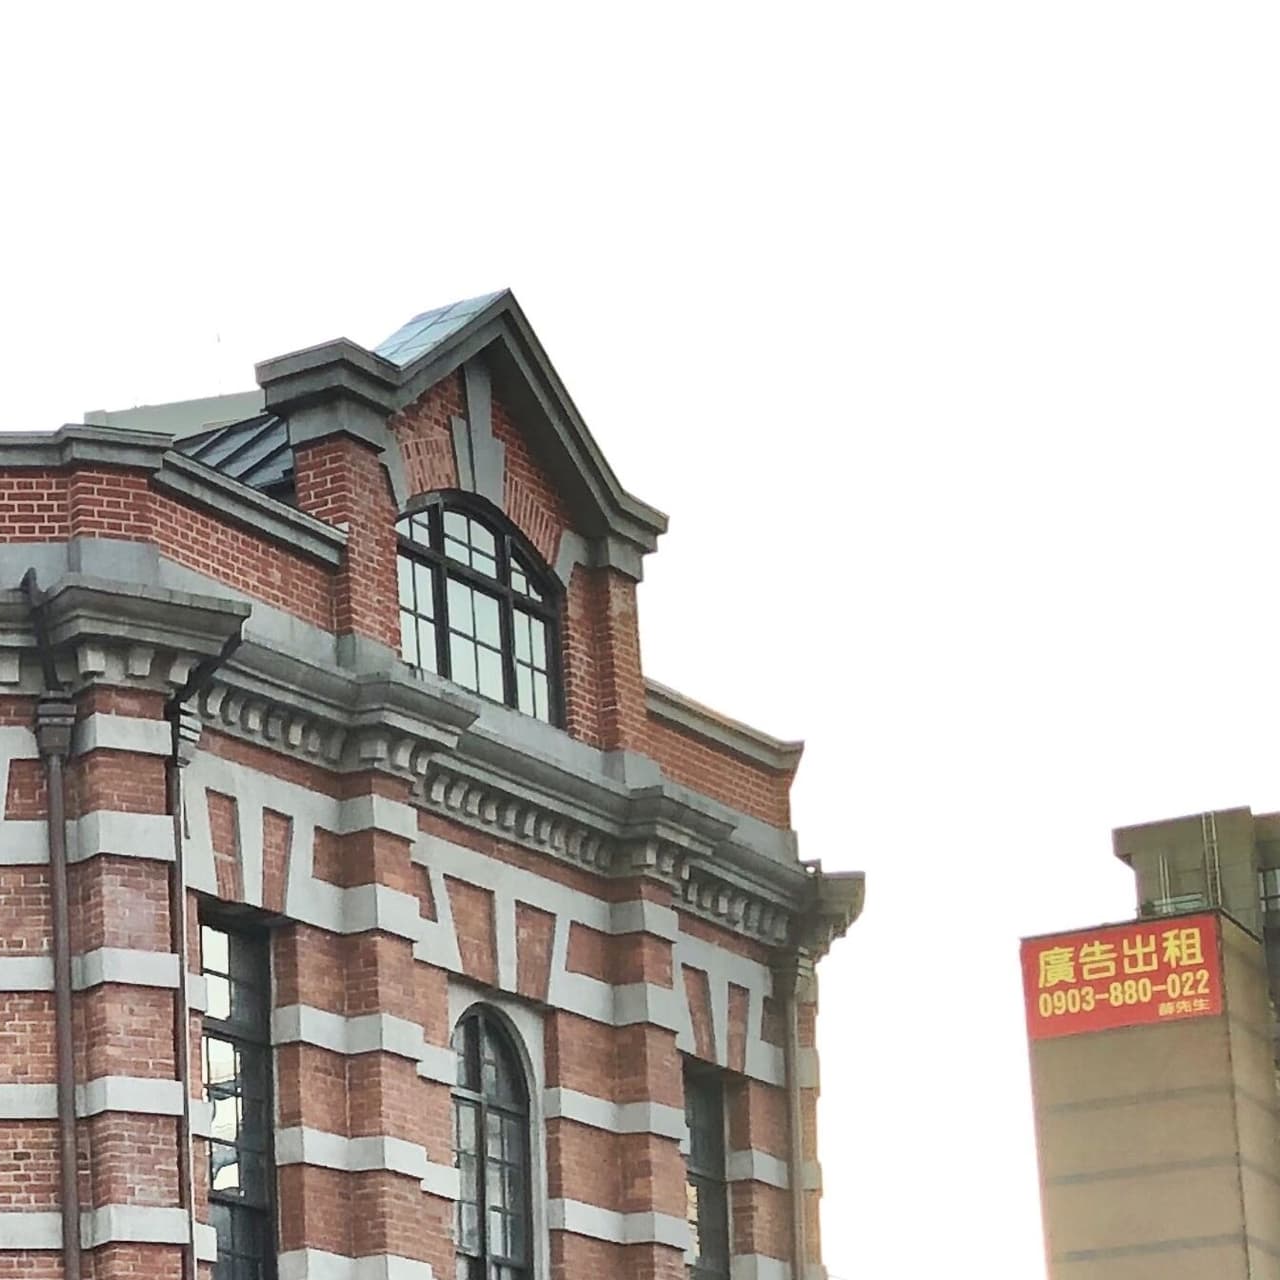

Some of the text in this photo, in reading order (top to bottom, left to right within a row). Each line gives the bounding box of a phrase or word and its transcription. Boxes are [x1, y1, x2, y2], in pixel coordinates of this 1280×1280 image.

[1038, 927, 1205, 989] 廣告出租
[1039, 969, 1210, 1018] 0903-880-022
